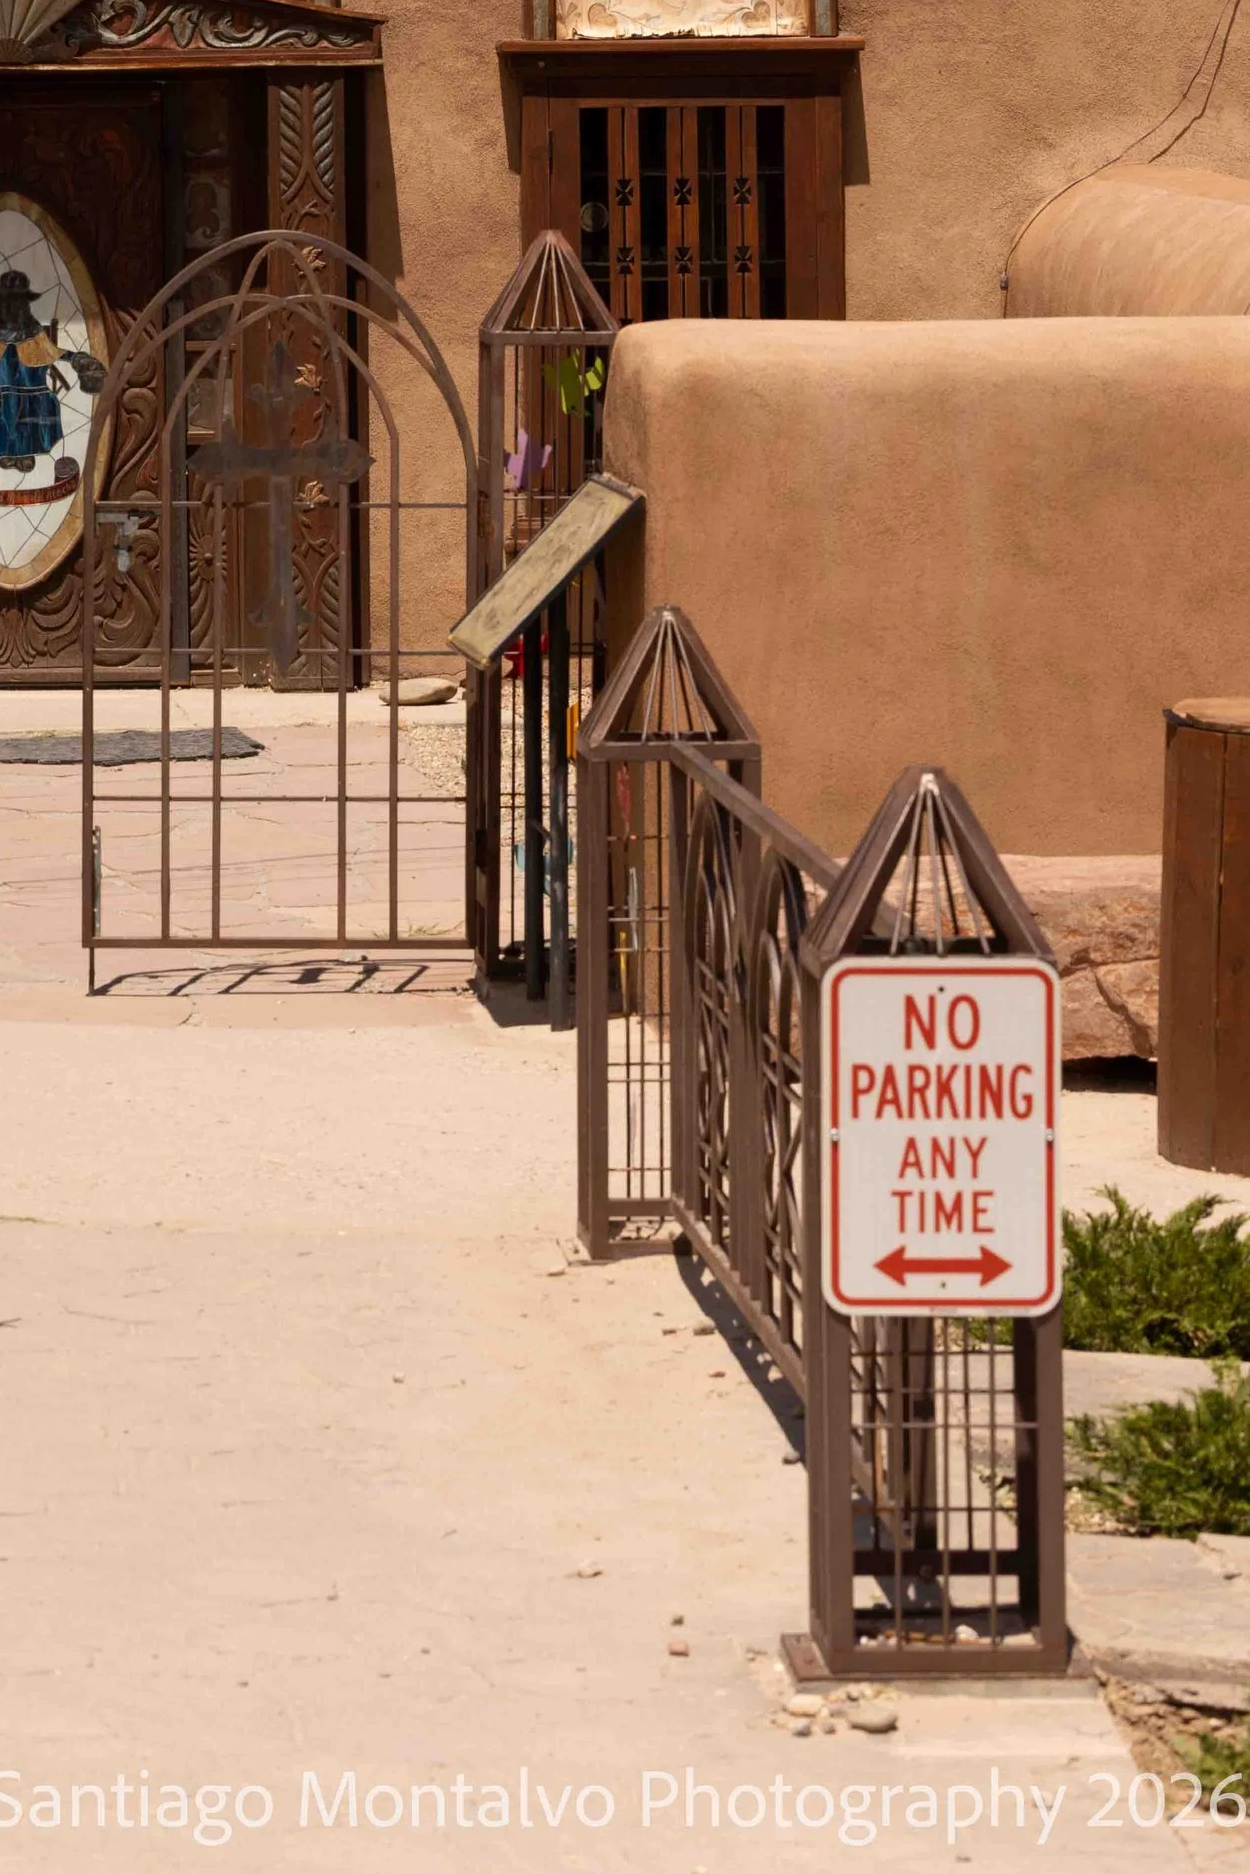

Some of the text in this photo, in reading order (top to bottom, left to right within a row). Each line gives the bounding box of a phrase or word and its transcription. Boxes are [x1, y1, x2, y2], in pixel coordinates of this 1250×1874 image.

[904, 994, 980, 1051] NO
[851, 1064, 1033, 1120] PARKING
[898, 1136, 987, 1180] ANY
[891, 1189, 995, 1234] TIME
